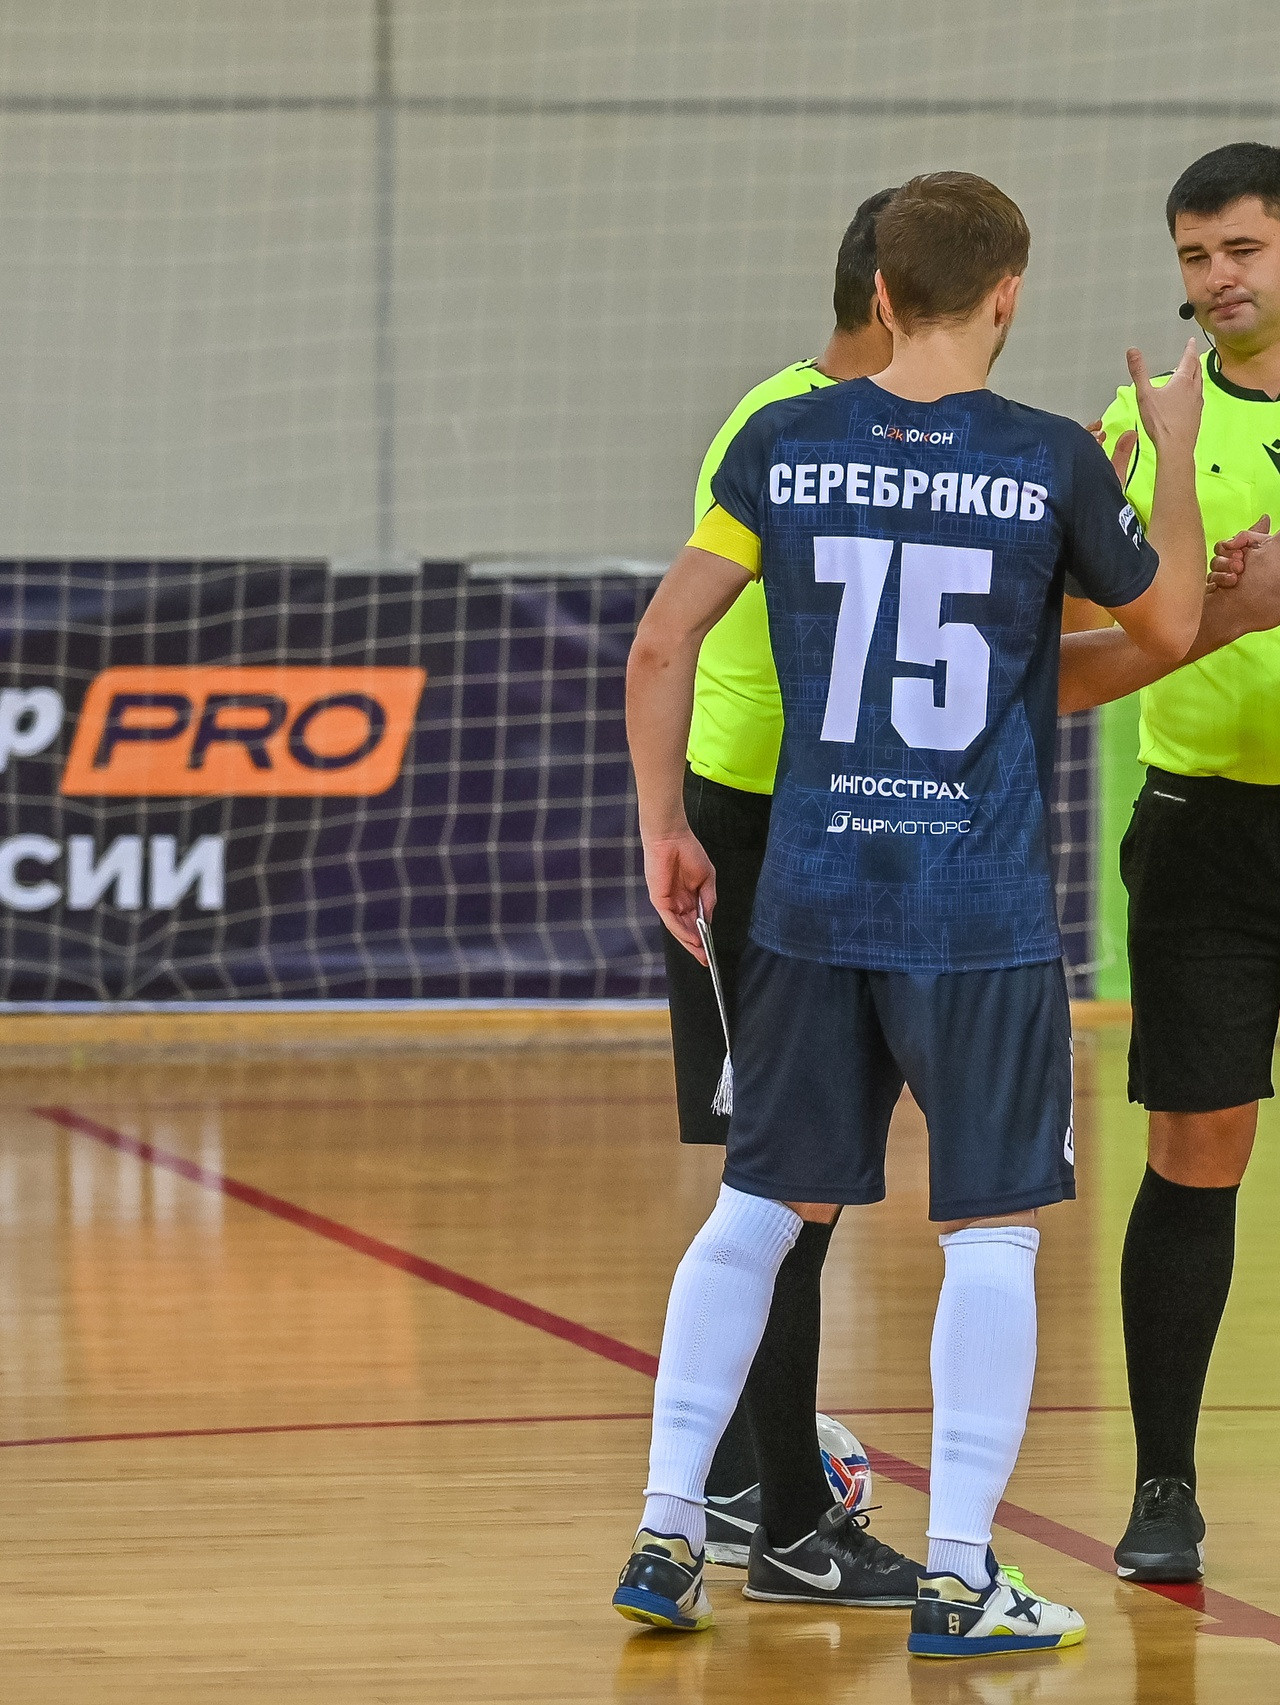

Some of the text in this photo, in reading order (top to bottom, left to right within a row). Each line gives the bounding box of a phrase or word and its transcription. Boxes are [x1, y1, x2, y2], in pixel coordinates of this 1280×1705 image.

[769, 463, 1048, 521] СЕРЕБРЯКОВ
[813, 536, 993, 751] 75
[92, 694, 387, 769] PRO
[830, 774, 970, 800] ИНГОССТРАХ
